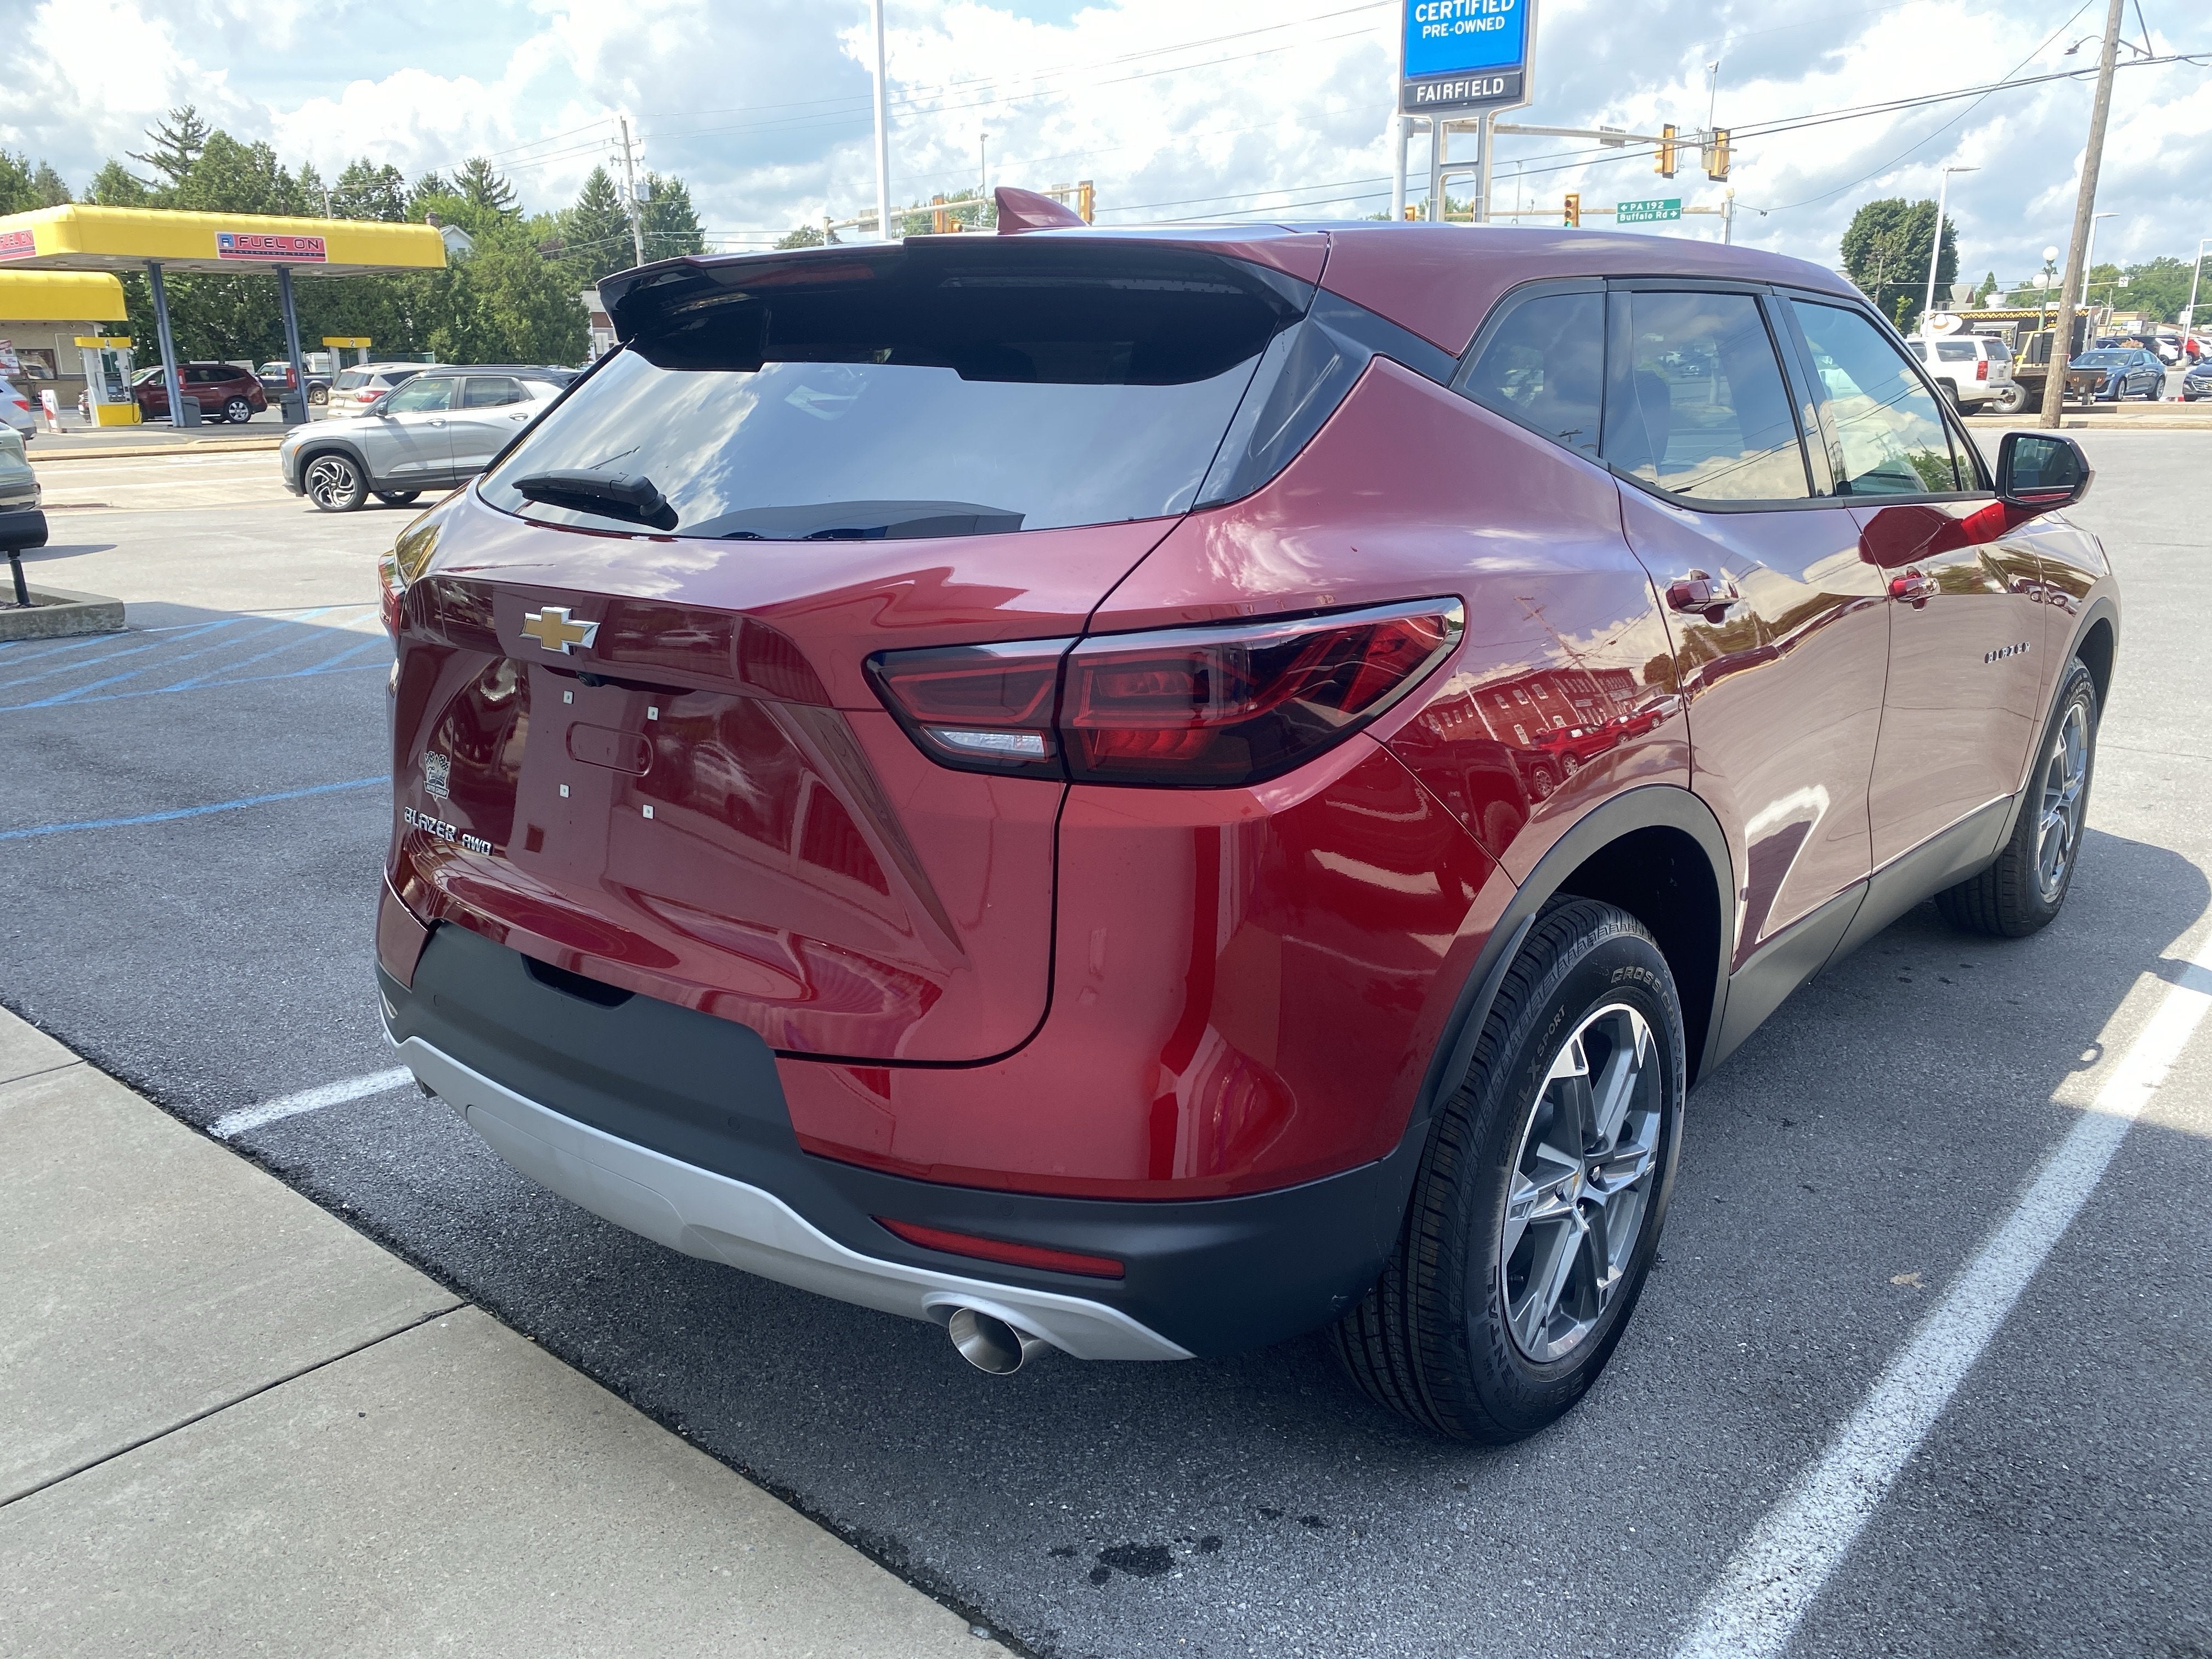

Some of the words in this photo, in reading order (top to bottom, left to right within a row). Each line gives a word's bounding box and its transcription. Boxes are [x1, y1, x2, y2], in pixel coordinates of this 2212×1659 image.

[1415, 0, 1515, 22] CERTIFIED
[1422, 16, 1505, 39] PRE-OWNED
[1417, 78, 1504, 103] FAIRFIELD
[1620, 212, 1653, 221] Buffalo
[1630, 202, 1643, 211] PA
[1646, 201, 1664, 210] 192
[239, 236, 286, 249] FUEL
[294, 239, 319, 250] ON
[1984, 641, 2030, 664] BLAZER
[404, 806, 458, 843] BLAZER
[462, 833, 493, 856] AWD
[1610, 966, 1663, 994] CROSS
[1537, 1004, 1566, 1057] SPORT
